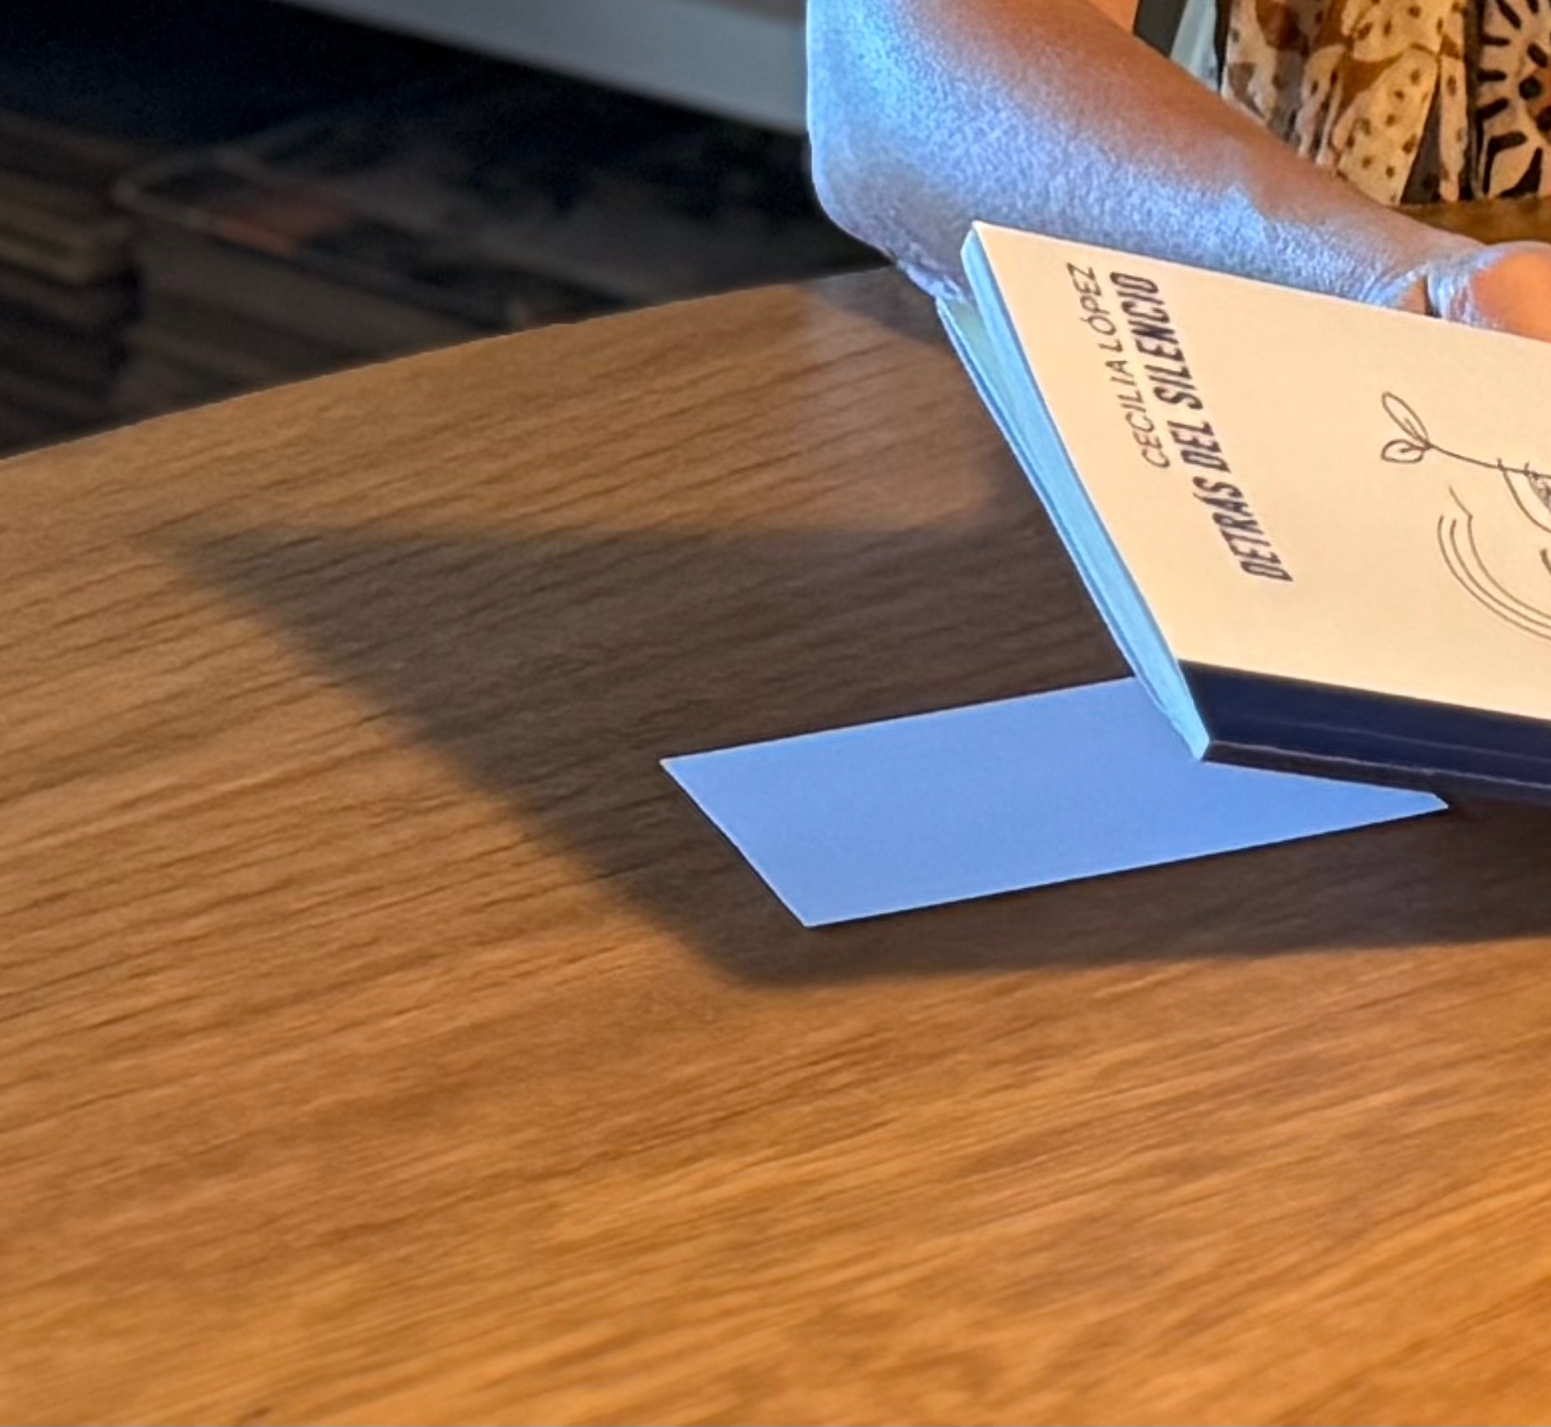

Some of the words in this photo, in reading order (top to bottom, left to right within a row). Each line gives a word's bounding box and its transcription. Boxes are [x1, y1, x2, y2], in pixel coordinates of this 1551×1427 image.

[1066, 261, 1125, 355] LÓPEZ
[1109, 270, 1204, 411] SILENCIO
[1105, 359, 1170, 469] CECILIA
[1167, 419, 1232, 474] DEL
[1192, 475, 1294, 583] DETRÁS
